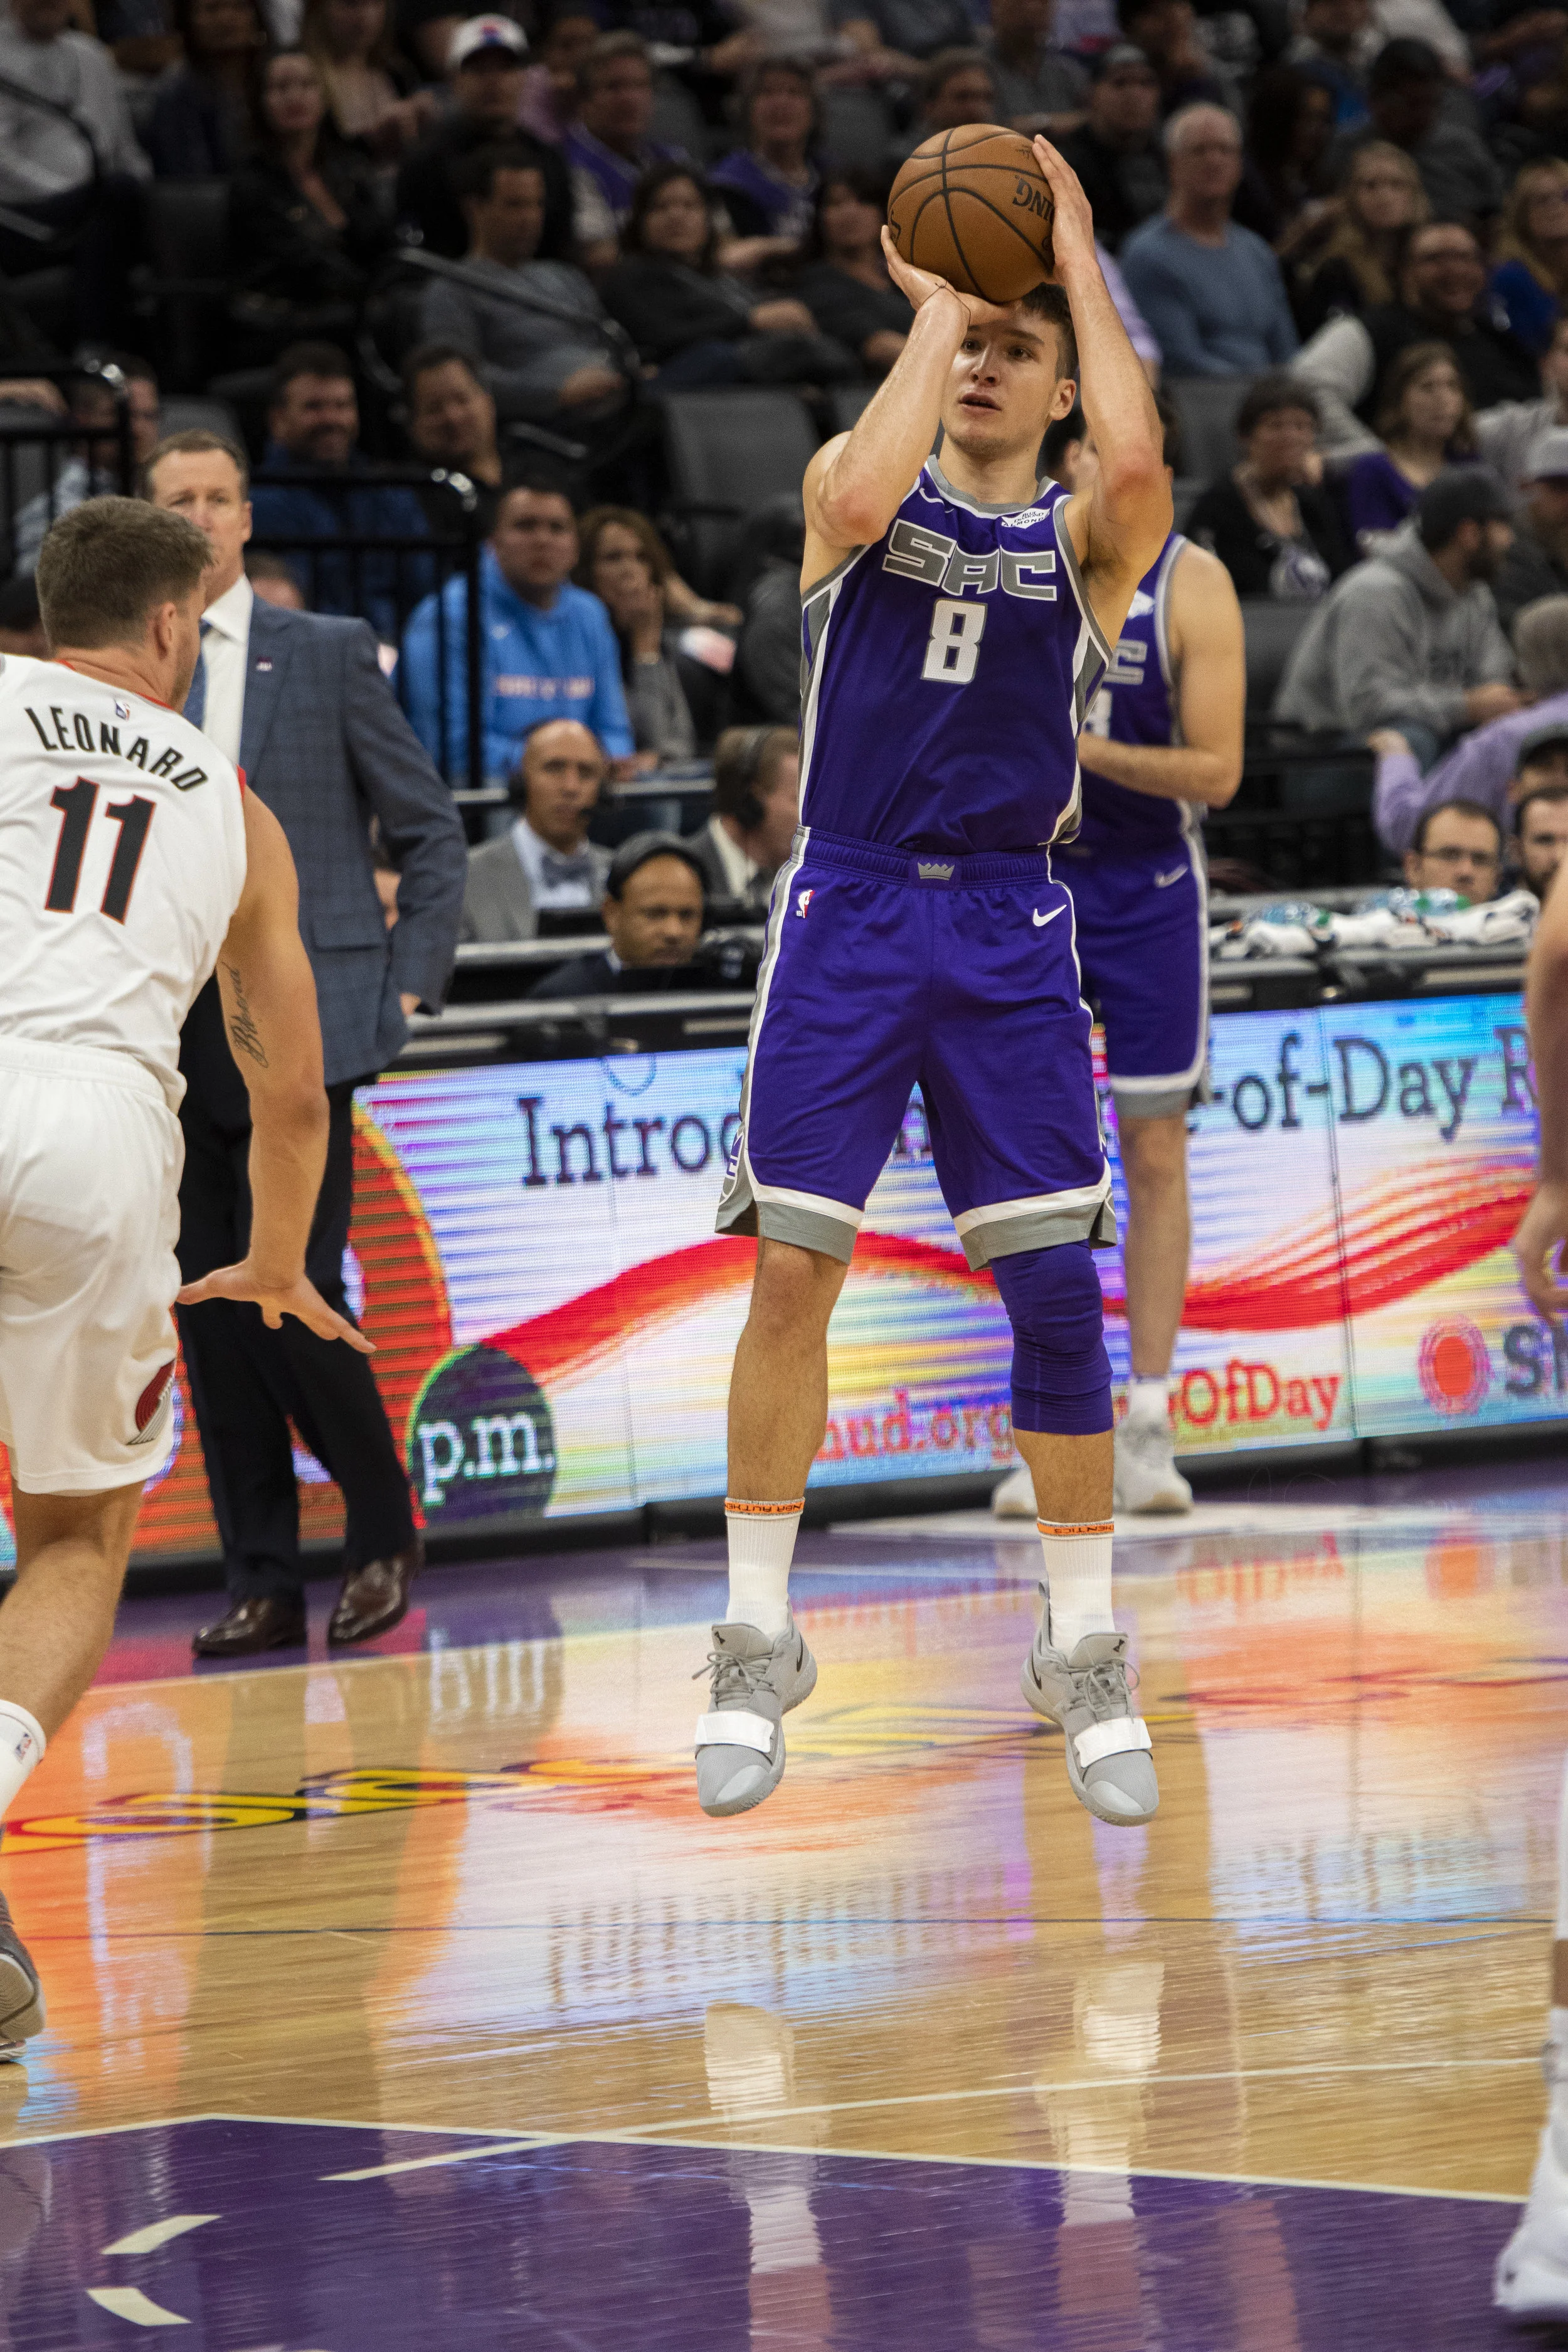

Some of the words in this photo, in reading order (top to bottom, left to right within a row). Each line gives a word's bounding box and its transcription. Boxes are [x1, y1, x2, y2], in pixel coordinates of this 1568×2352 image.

[882, 518, 1057, 601] SAC
[1014, 512, 1044, 523] DIAMOND
[920, 598, 988, 685] 8
[24, 704, 209, 792] LEONARD
[44, 775, 157, 926] 11
[1187, 1030, 1479, 1143] -of-Day
[1168, 1358, 1342, 1431] OfDay
[416, 1413, 553, 1507] p.m.
[1054, 1525, 1114, 1534] HENTICS
